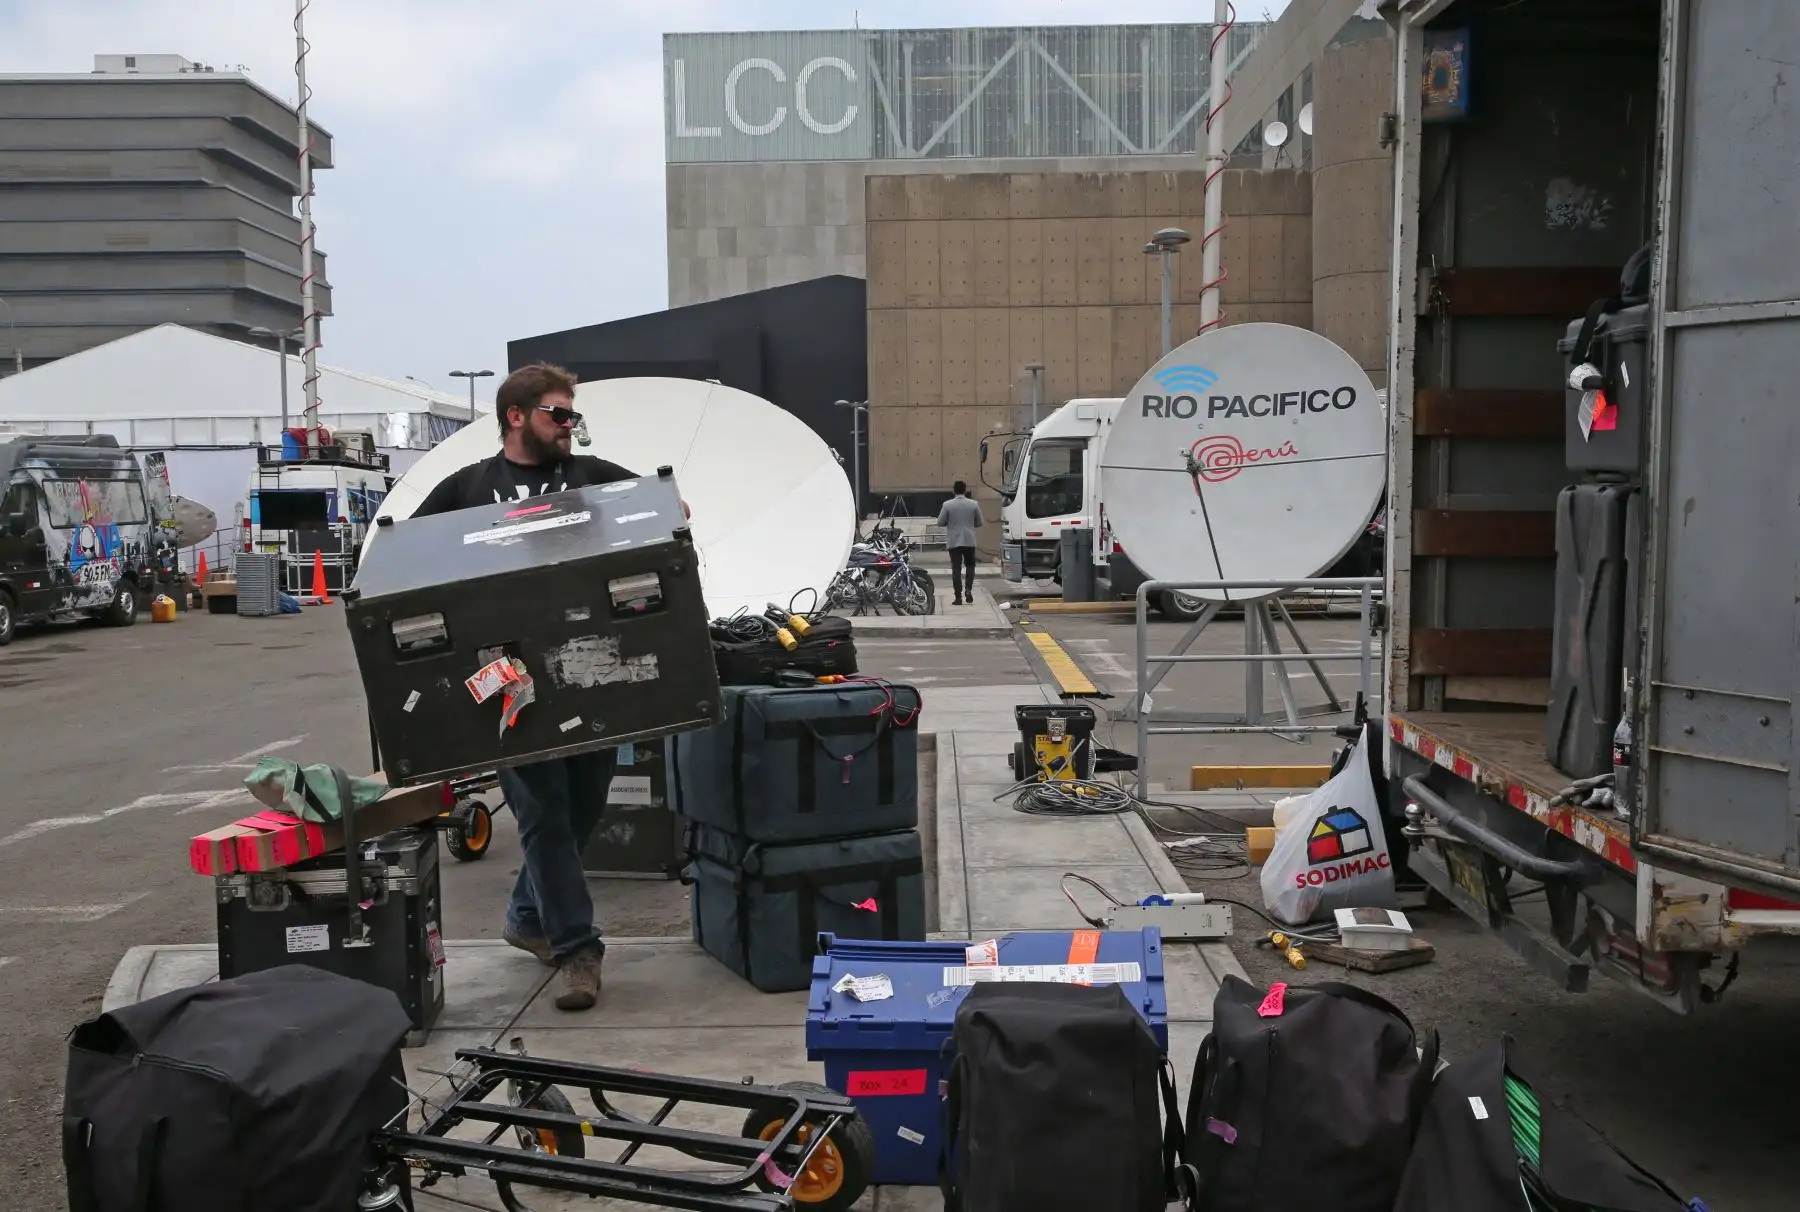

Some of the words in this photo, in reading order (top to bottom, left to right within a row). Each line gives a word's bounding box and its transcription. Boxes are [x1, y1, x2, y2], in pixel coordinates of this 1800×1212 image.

[674, 57, 858, 137] LCC
[1142, 394, 1197, 418] RIO
[1207, 386, 1357, 419] PACIFICO
[1296, 852, 1390, 889] SODIMAC
